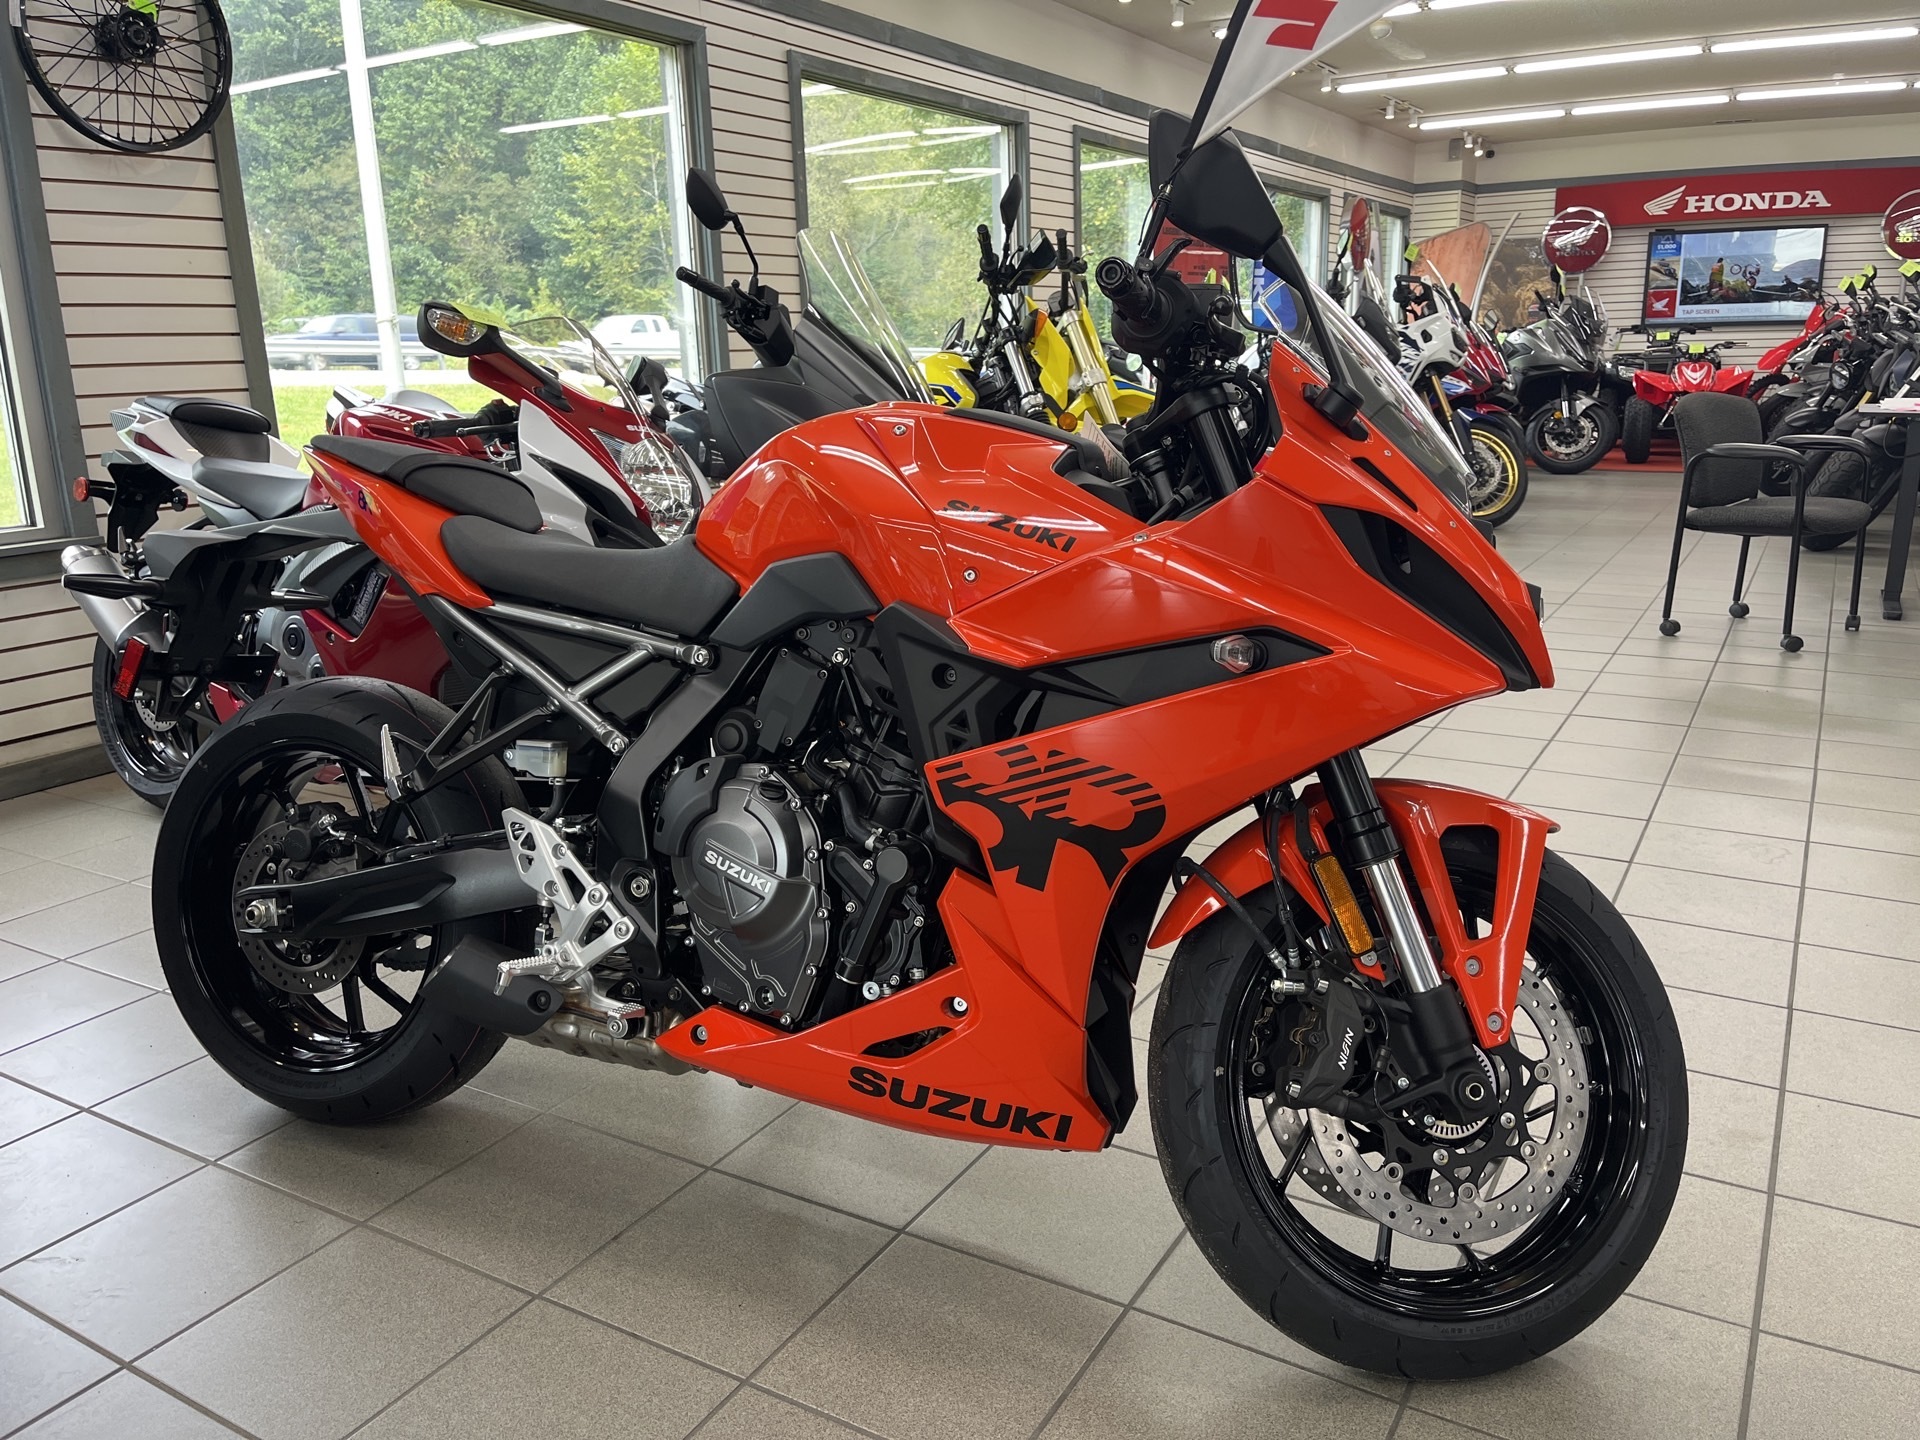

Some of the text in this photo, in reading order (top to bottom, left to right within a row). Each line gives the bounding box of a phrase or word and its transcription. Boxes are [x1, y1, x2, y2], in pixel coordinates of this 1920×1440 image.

[1684, 190, 1831, 213] HONDA
[704, 850, 771, 893] SUZUKI
[1337, 1027, 1354, 1071] NISSIN
[848, 1066, 1073, 1143] SUZUKI
